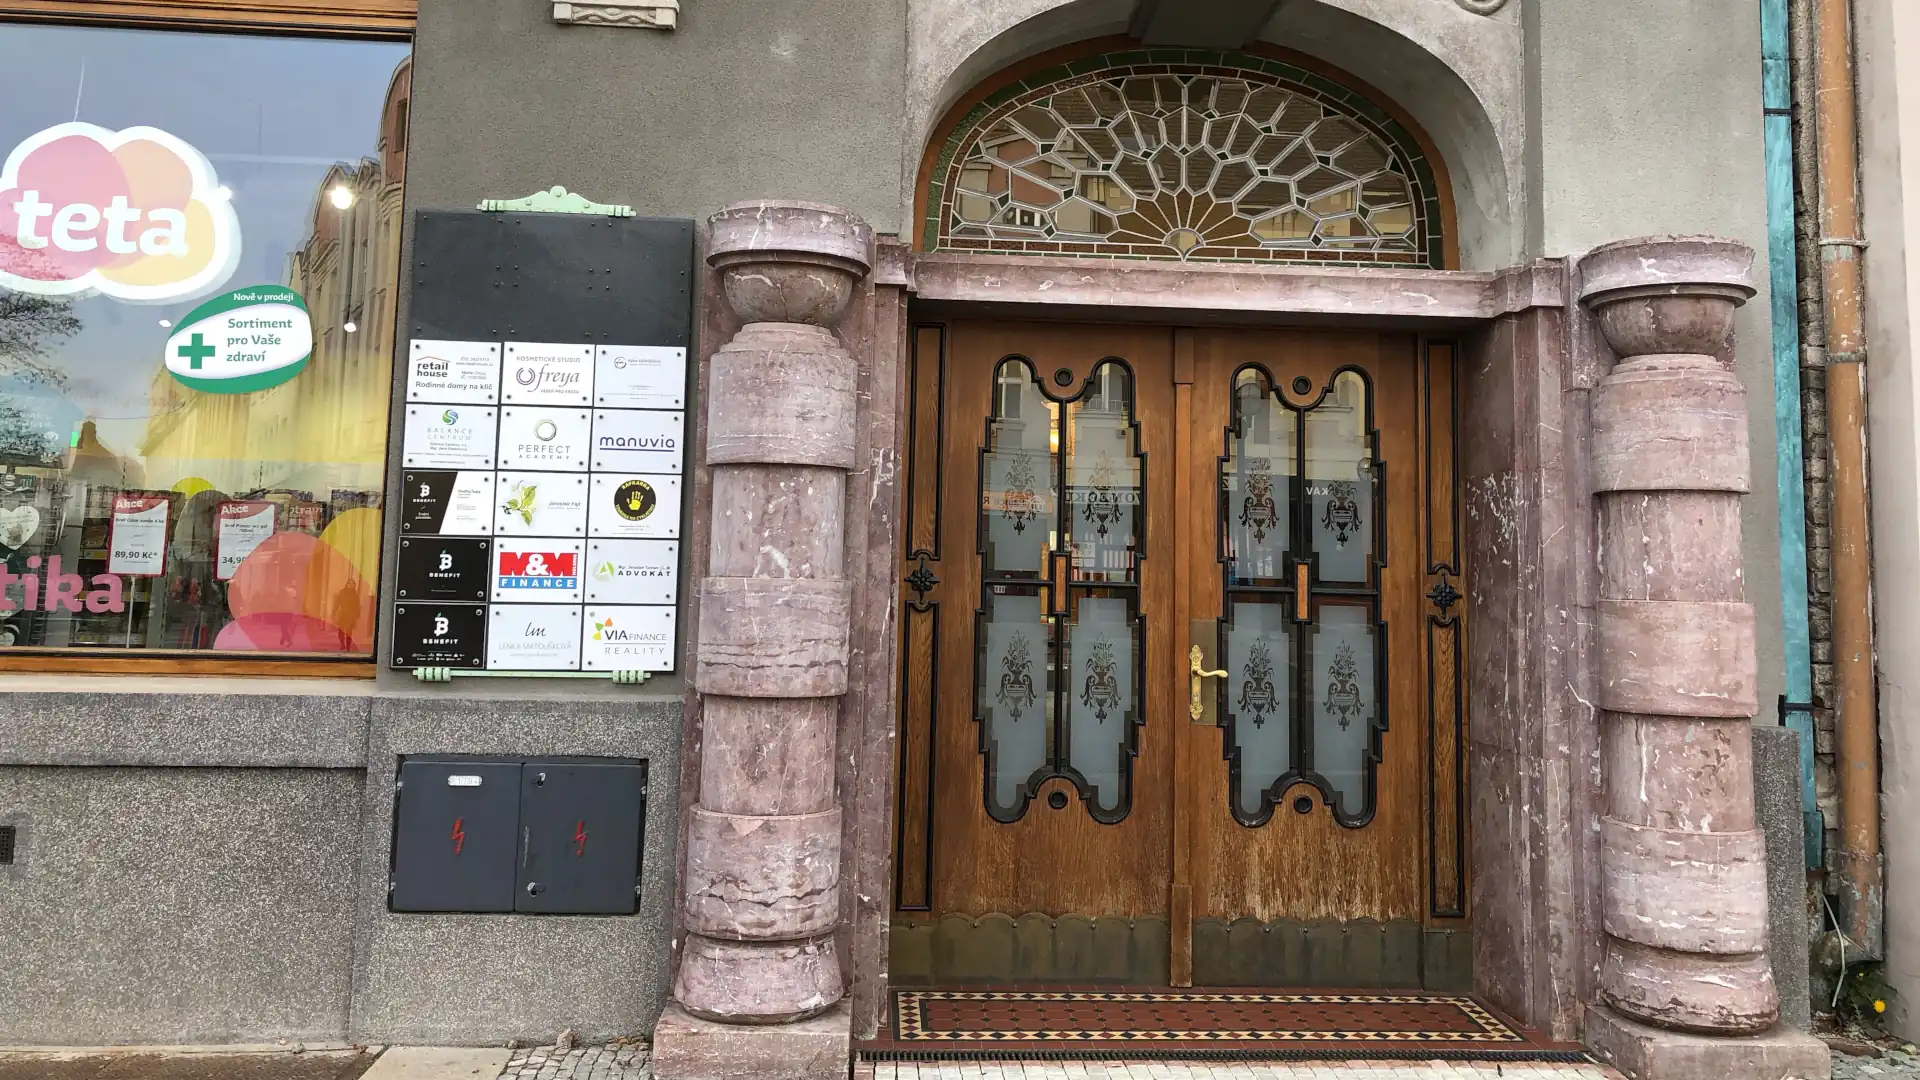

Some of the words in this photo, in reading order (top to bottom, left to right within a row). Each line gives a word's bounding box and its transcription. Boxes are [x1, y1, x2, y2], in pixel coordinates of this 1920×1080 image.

[14, 190, 190, 258] teta
[233, 293, 256, 301] Nově
[227, 318, 293, 330] Sortiment
[227, 336, 247, 347] pro
[251, 333, 282, 346] Vaše
[226, 350, 266, 362] zdraví
[417, 362, 449, 370] retail
[527, 363, 580, 392] freya
[447, 382, 468, 390] domy
[427, 427, 473, 435] BALANCE
[600, 434, 675, 448] manuvia
[518, 444, 571, 454] PERFECT
[115, 499, 144, 510] Akce
[221, 504, 249, 515] Akce
[114, 550, 140, 559] 89,90
[499, 552, 573, 576] M&M
[618, 569, 671, 577] ADVOKÁT
[501, 578, 574, 587] FINANCE
[604, 629, 628, 641] VIA
[629, 633, 667, 641] FINANCE
[498, 642, 521, 650] LENKA
[604, 647, 664, 655] REALITY
